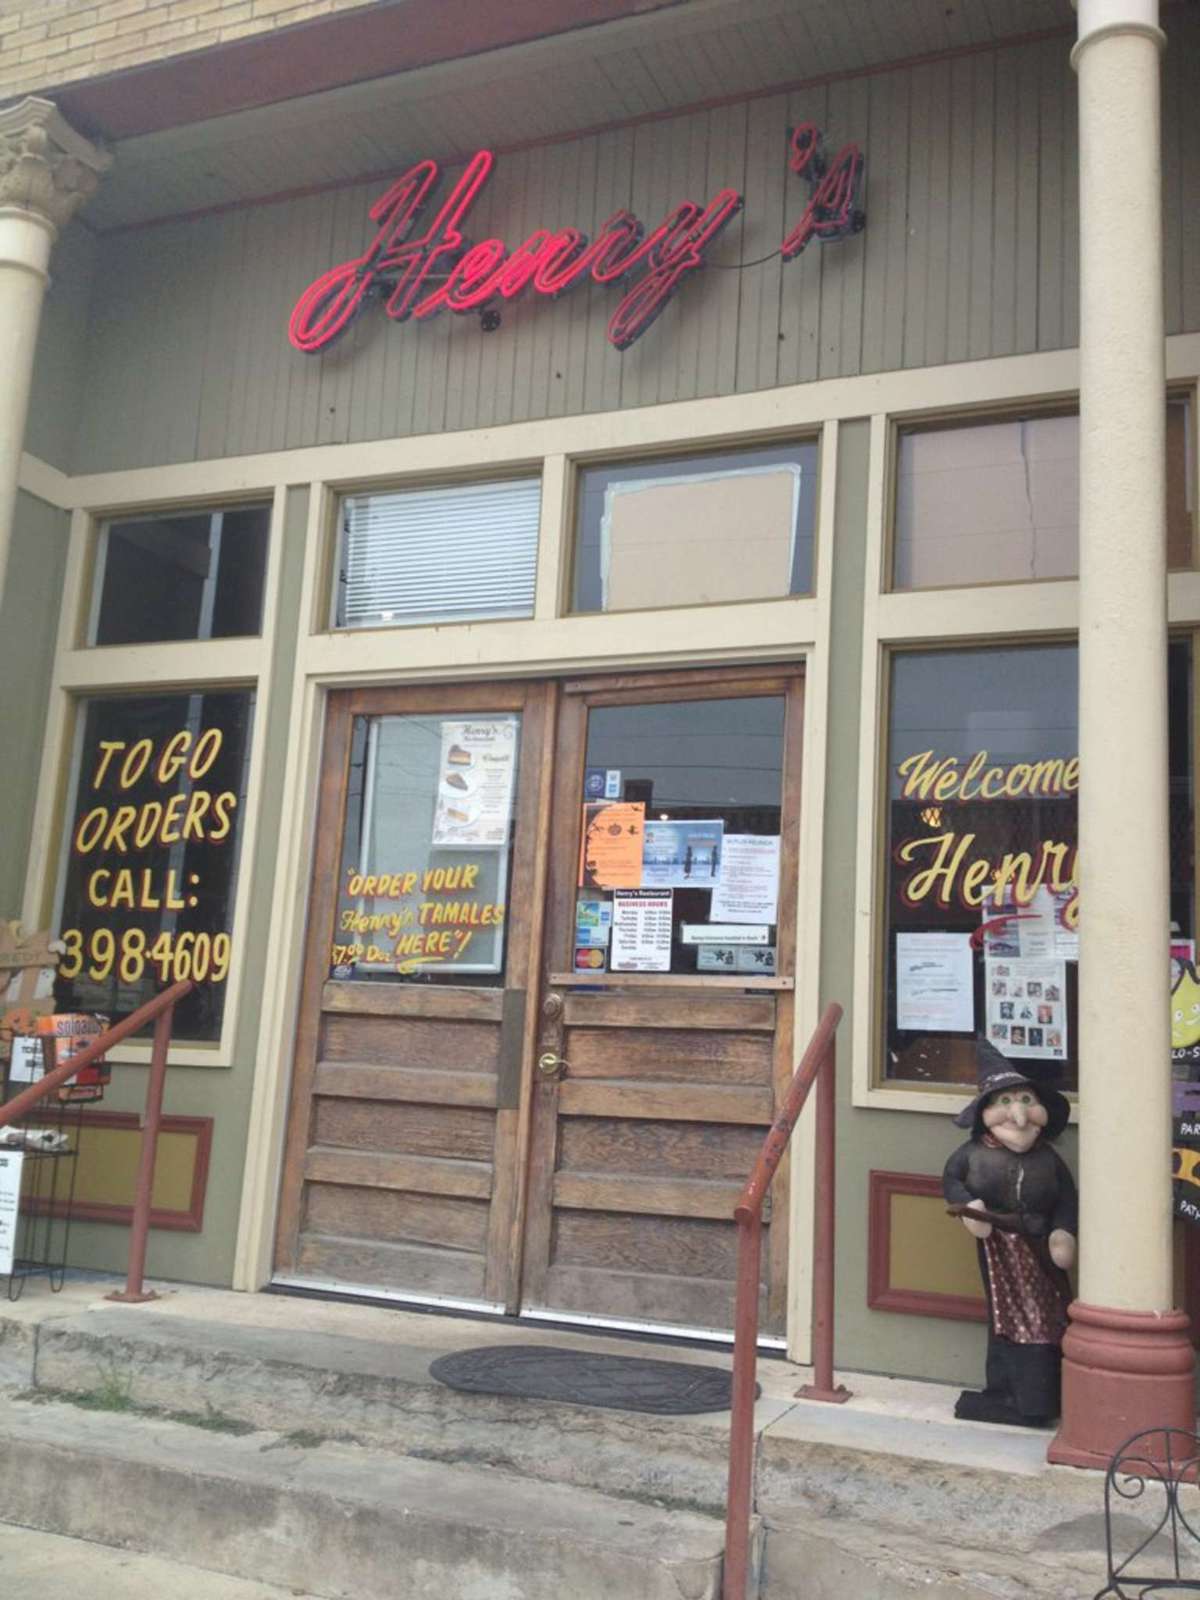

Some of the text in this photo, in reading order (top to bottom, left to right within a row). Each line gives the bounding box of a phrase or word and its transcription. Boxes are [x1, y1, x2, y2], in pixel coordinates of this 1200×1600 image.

[289, 122, 867, 352] Henry's
[93, 728, 223, 789] TO GO
[899, 750, 1079, 801] Welcome
[76, 791, 236, 852] ORDERS
[88, 868, 200, 909] CALL:
[422, 864, 479, 892] YOUR
[418, 902, 505, 926] TAMALES
